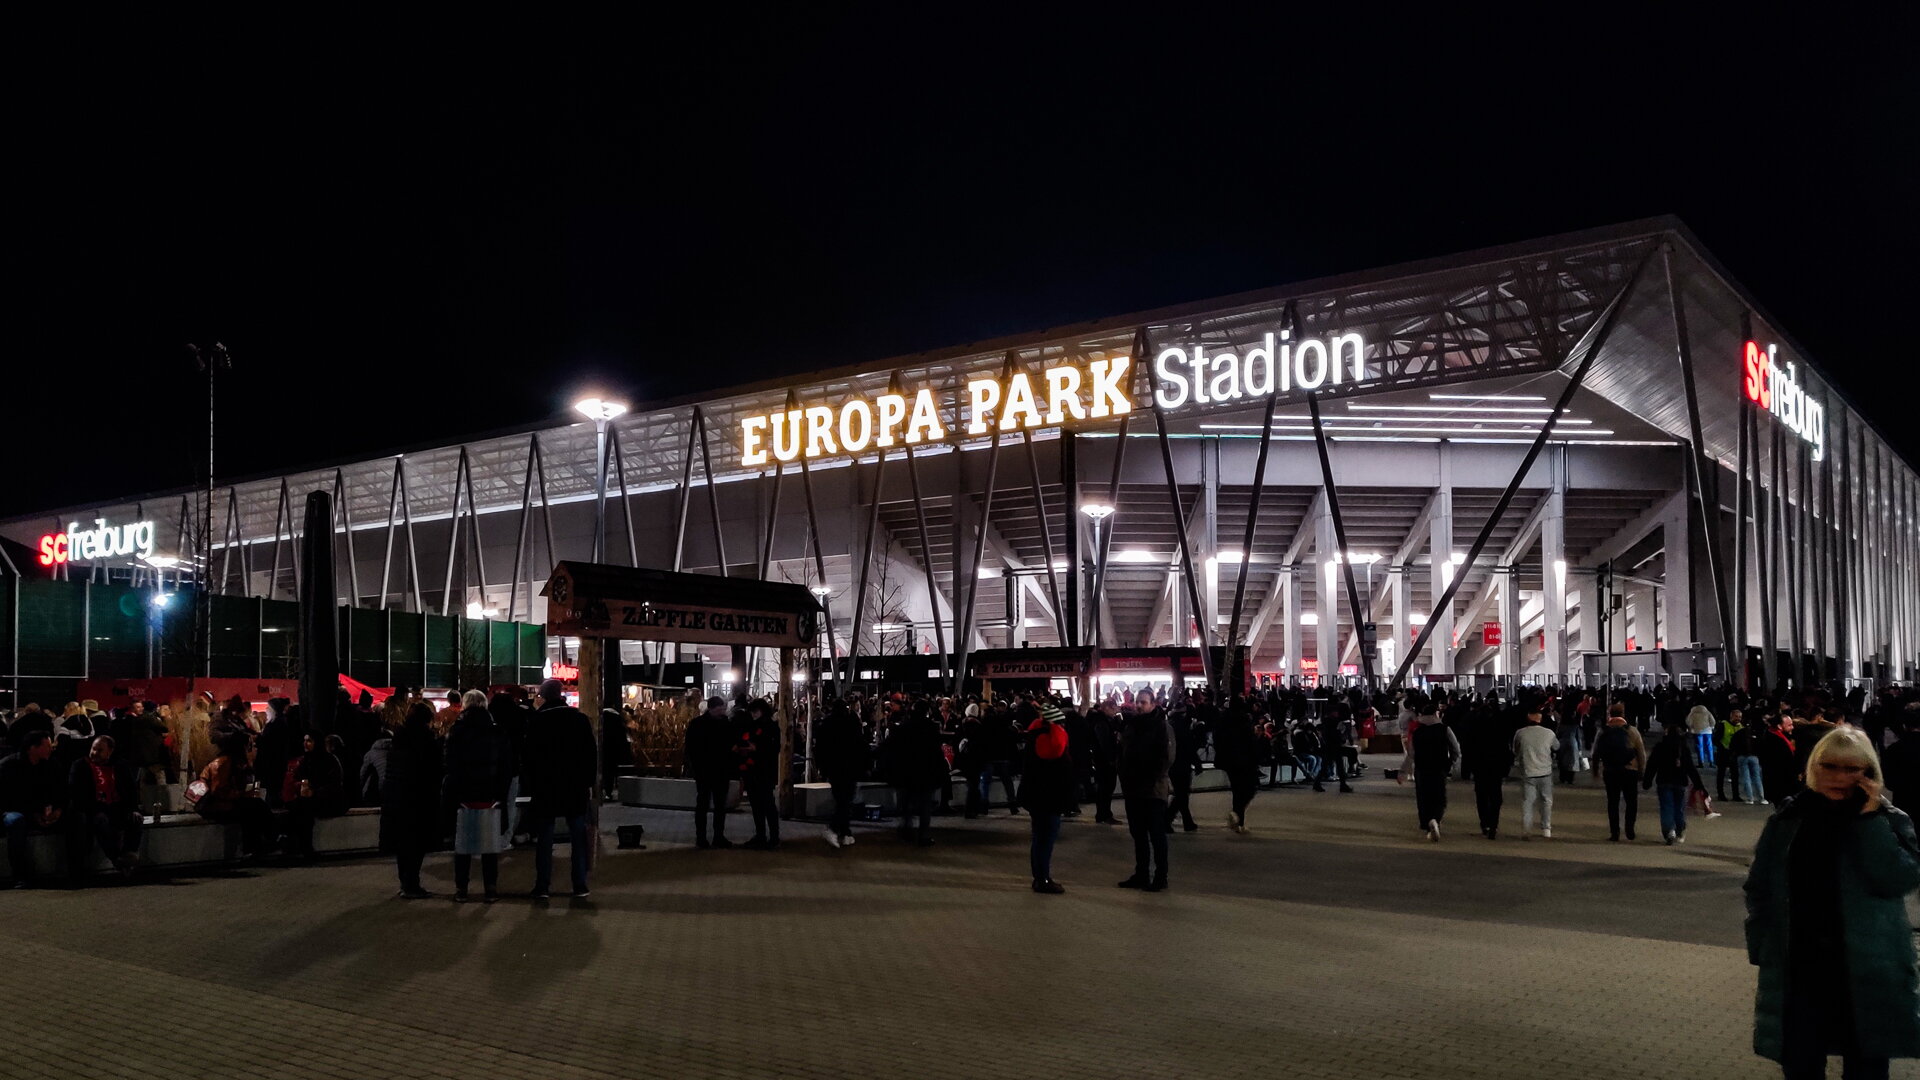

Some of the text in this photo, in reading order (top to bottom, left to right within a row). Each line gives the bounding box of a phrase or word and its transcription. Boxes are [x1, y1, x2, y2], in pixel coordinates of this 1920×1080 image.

[741, 329, 1364, 467] EUROPA PARK Stadion
[709, 613, 788, 635] GARTEN
